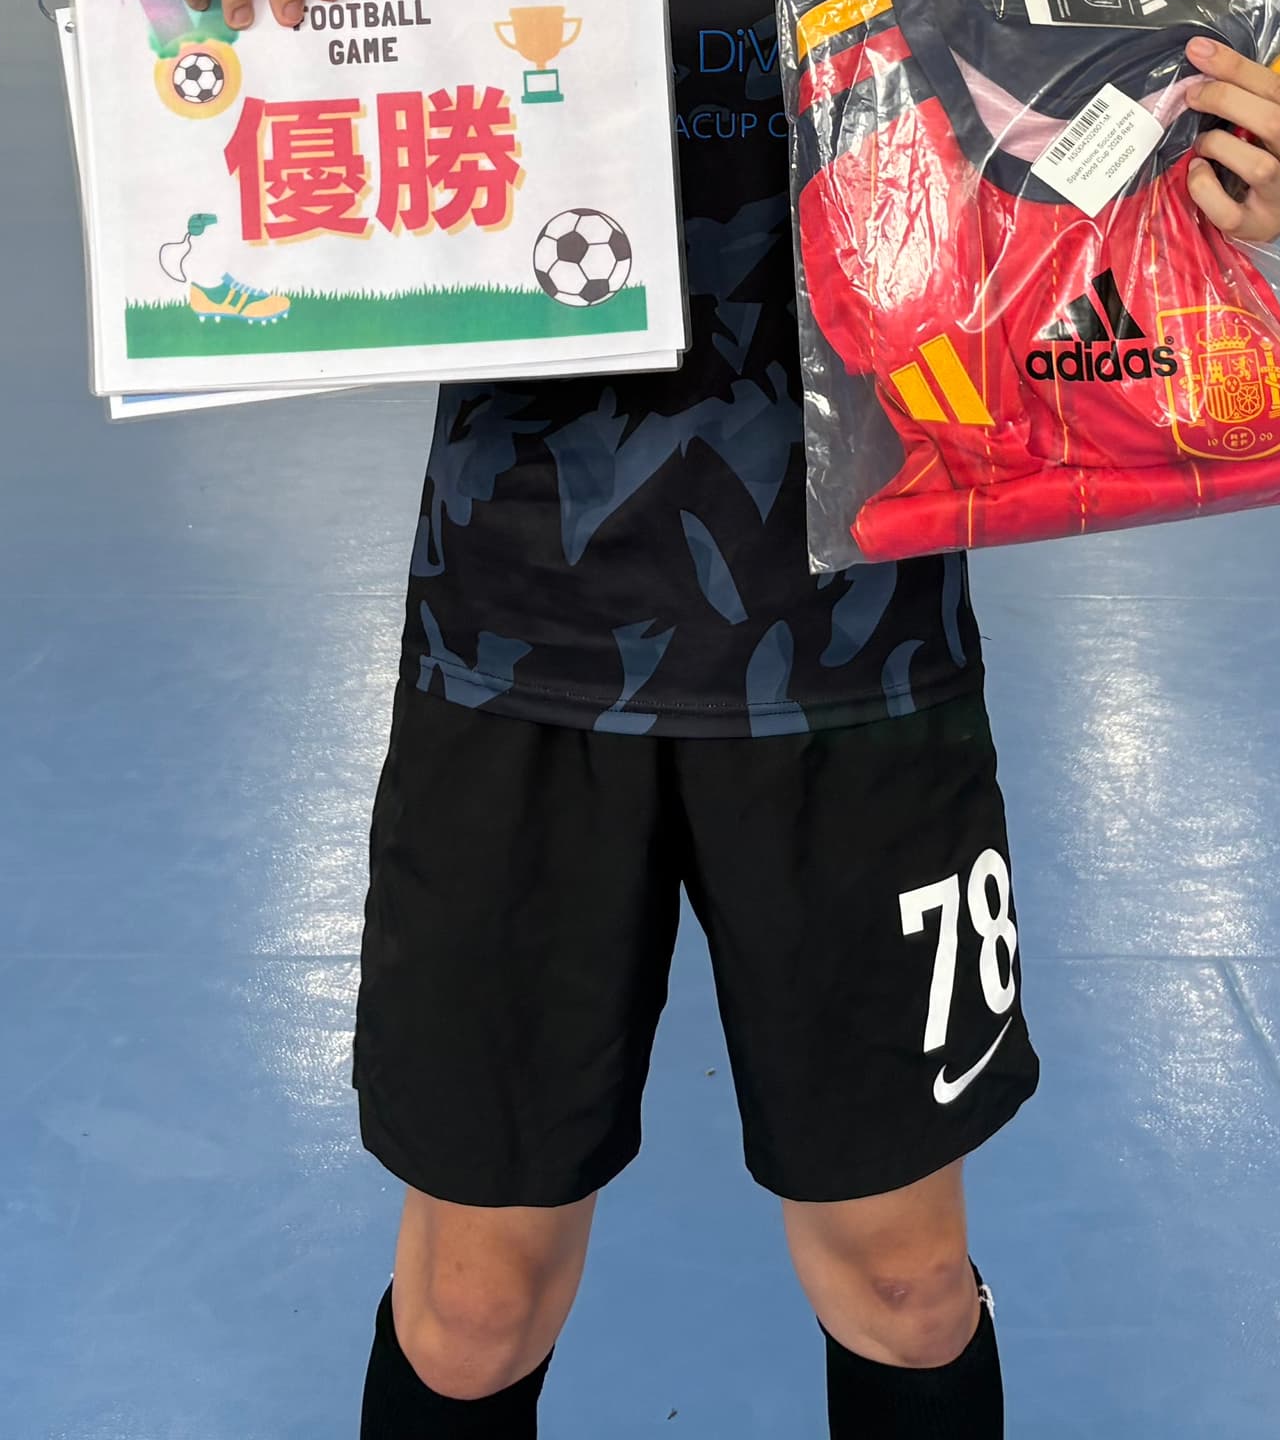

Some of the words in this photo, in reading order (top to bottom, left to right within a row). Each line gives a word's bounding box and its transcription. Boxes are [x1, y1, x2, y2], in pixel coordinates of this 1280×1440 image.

[329, 37, 398, 65] GAME
[223, 85, 521, 245] 優勝
[1066, 166, 1083, 184] Spain
[1081, 148, 1099, 167] Home
[1097, 127, 1117, 149] Soccer
[1116, 109, 1135, 129] Jersey
[1081, 163, 1098, 180] World
[1096, 150, 1110, 165] Cup
[1121, 121, 1134, 136] Red
[1025, 342, 1178, 382] adidas
[898, 848, 1017, 1053] 78
